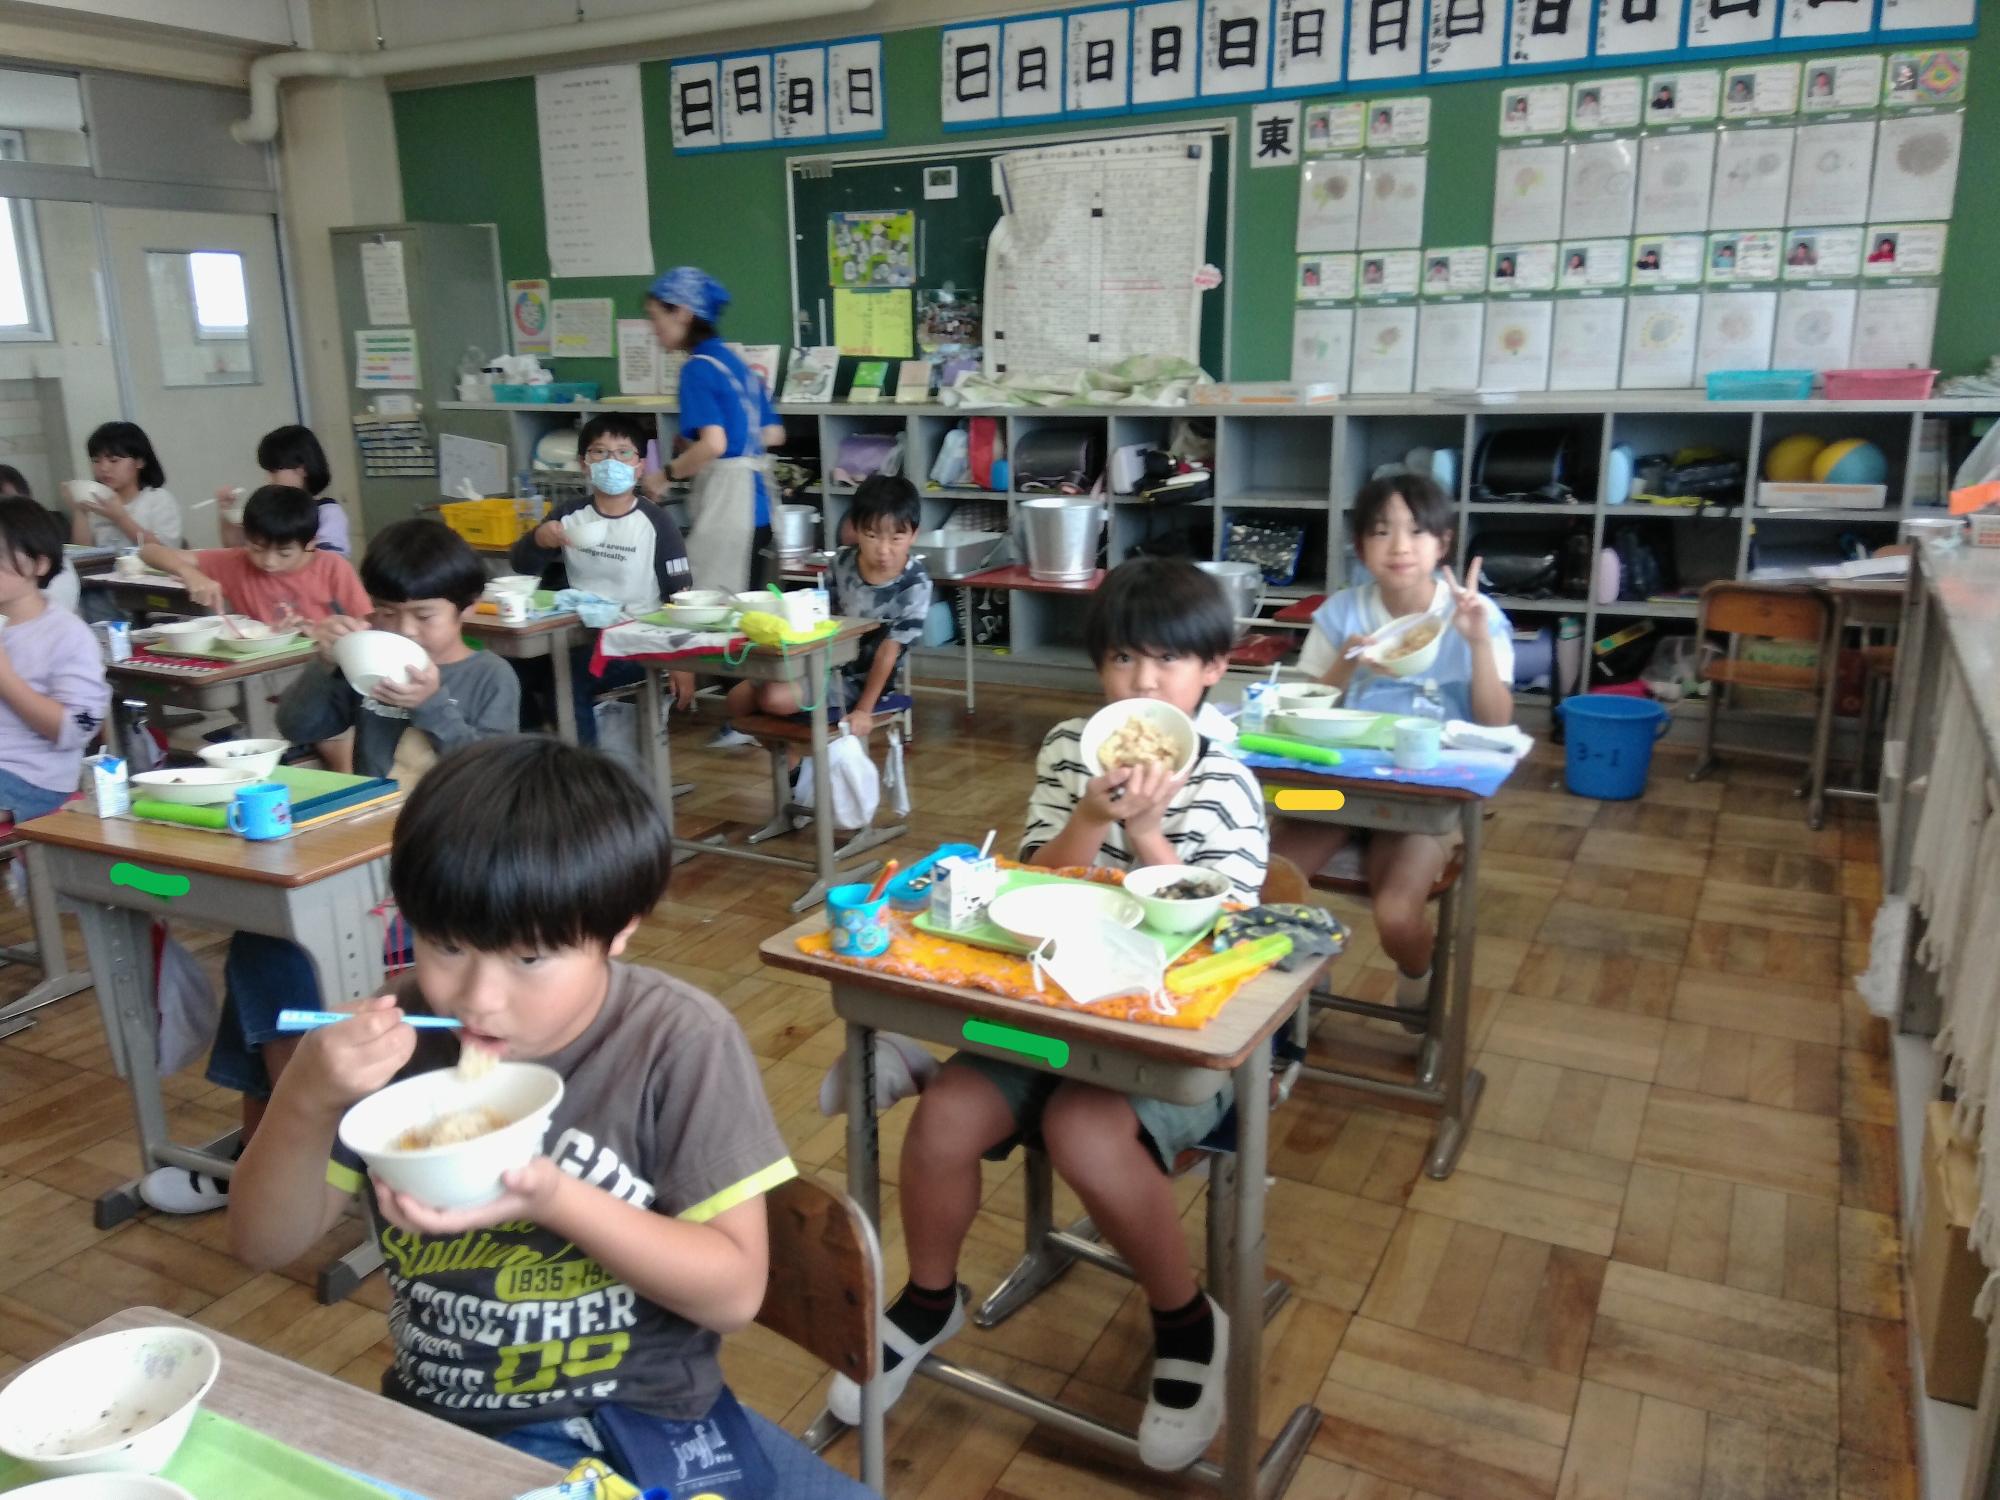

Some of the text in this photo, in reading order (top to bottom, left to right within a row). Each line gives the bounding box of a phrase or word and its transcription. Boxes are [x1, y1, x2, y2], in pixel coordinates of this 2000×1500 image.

[1151, 26, 1182, 77] 日
[1218, 17, 1258, 70] 日
[1292, 8, 1325, 57] 日
[1369, 0, 1410, 55] 日
[956, 43, 990, 102] 日
[1017, 46, 1046, 92] 日
[1086, 39, 1114, 83] 日
[680, 79, 715, 136] 日
[733, 65, 762, 115] 日
[789, 77, 813, 116] 日
[847, 68, 873, 116] 日
[1256, 115, 1296, 159] 東
[1577, 742, 1621, 769] 3-1
